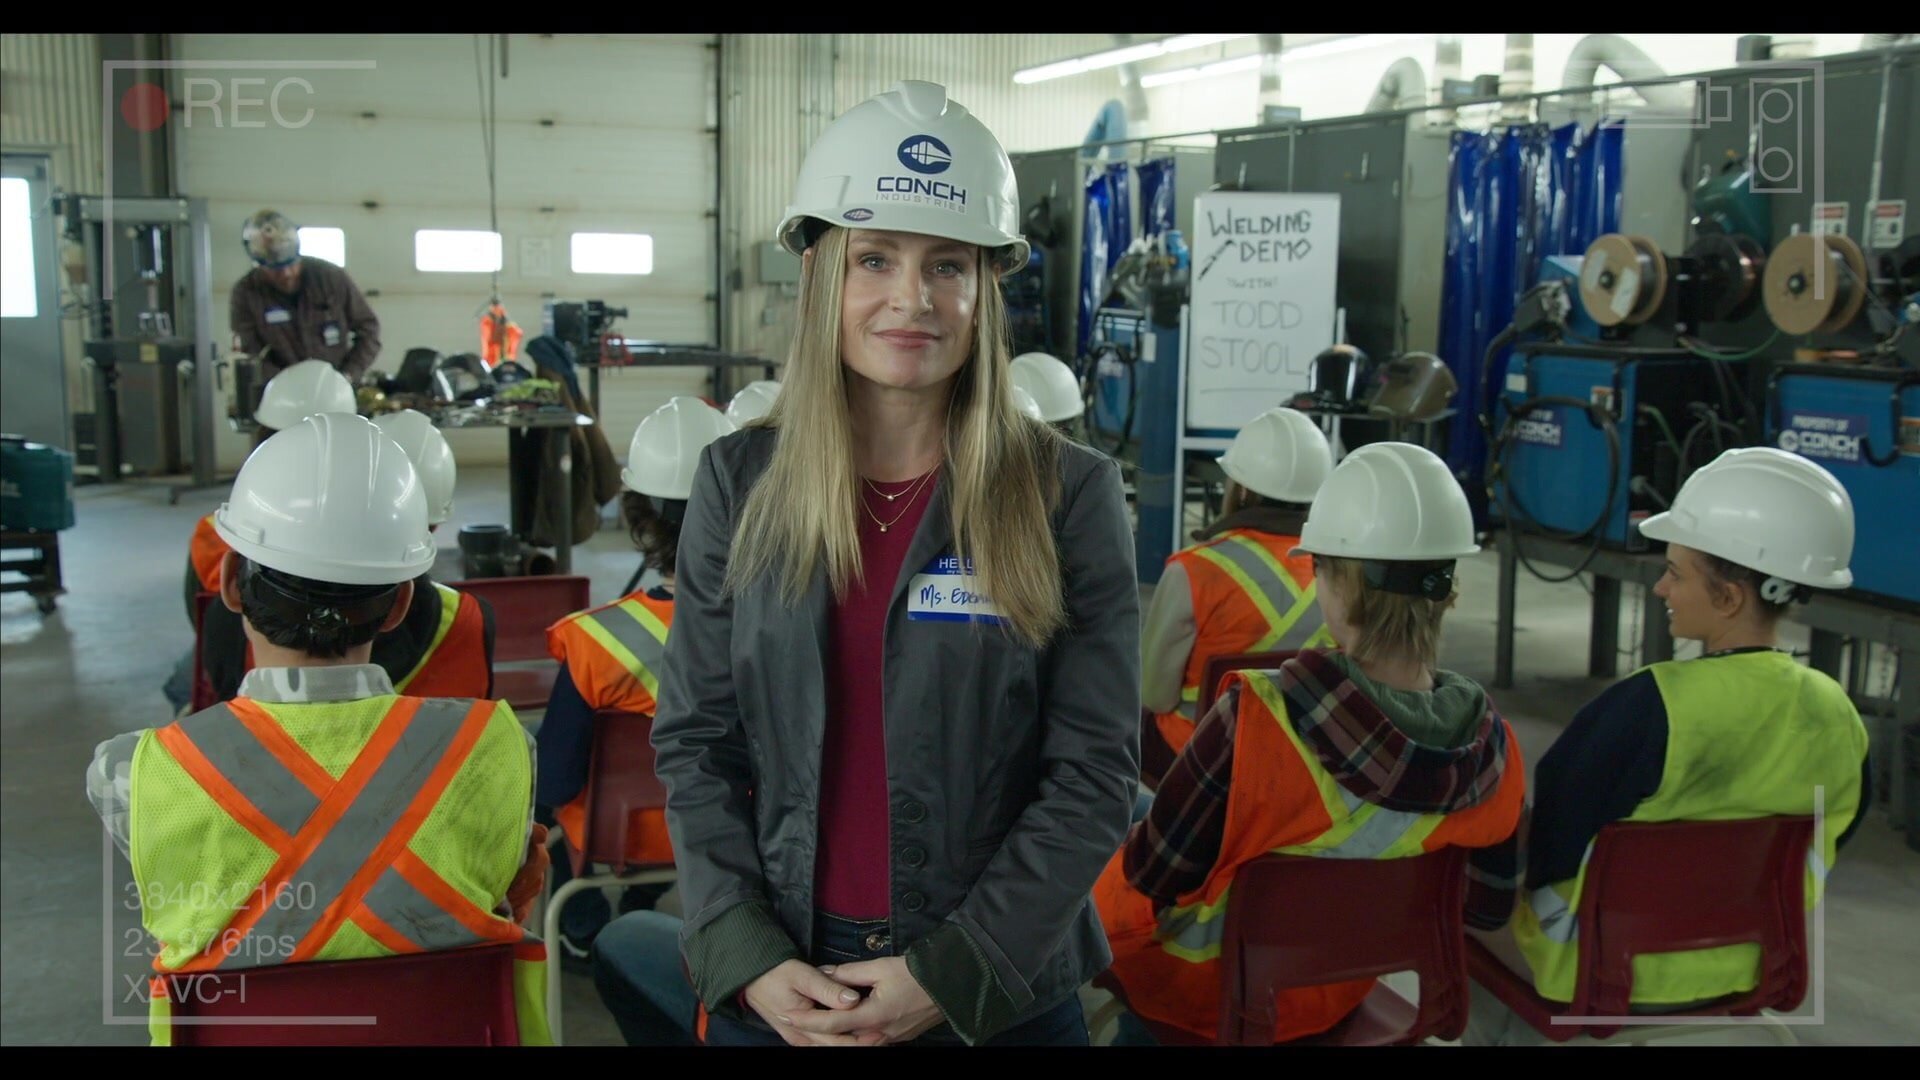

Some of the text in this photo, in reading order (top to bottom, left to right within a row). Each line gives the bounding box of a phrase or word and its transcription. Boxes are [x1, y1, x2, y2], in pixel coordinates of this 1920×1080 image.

[875, 193, 966, 214] INDUSTRIES
[877, 177, 966, 205] CONCH
[1207, 207, 1312, 237] WELDING
[1240, 238, 1312, 264] DEMO
[1212, 299, 1304, 330] TODD
[1200, 335, 1305, 377] STOOL
[1800, 431, 1860, 452] CONCH
[920, 584, 947, 608] Ms.
